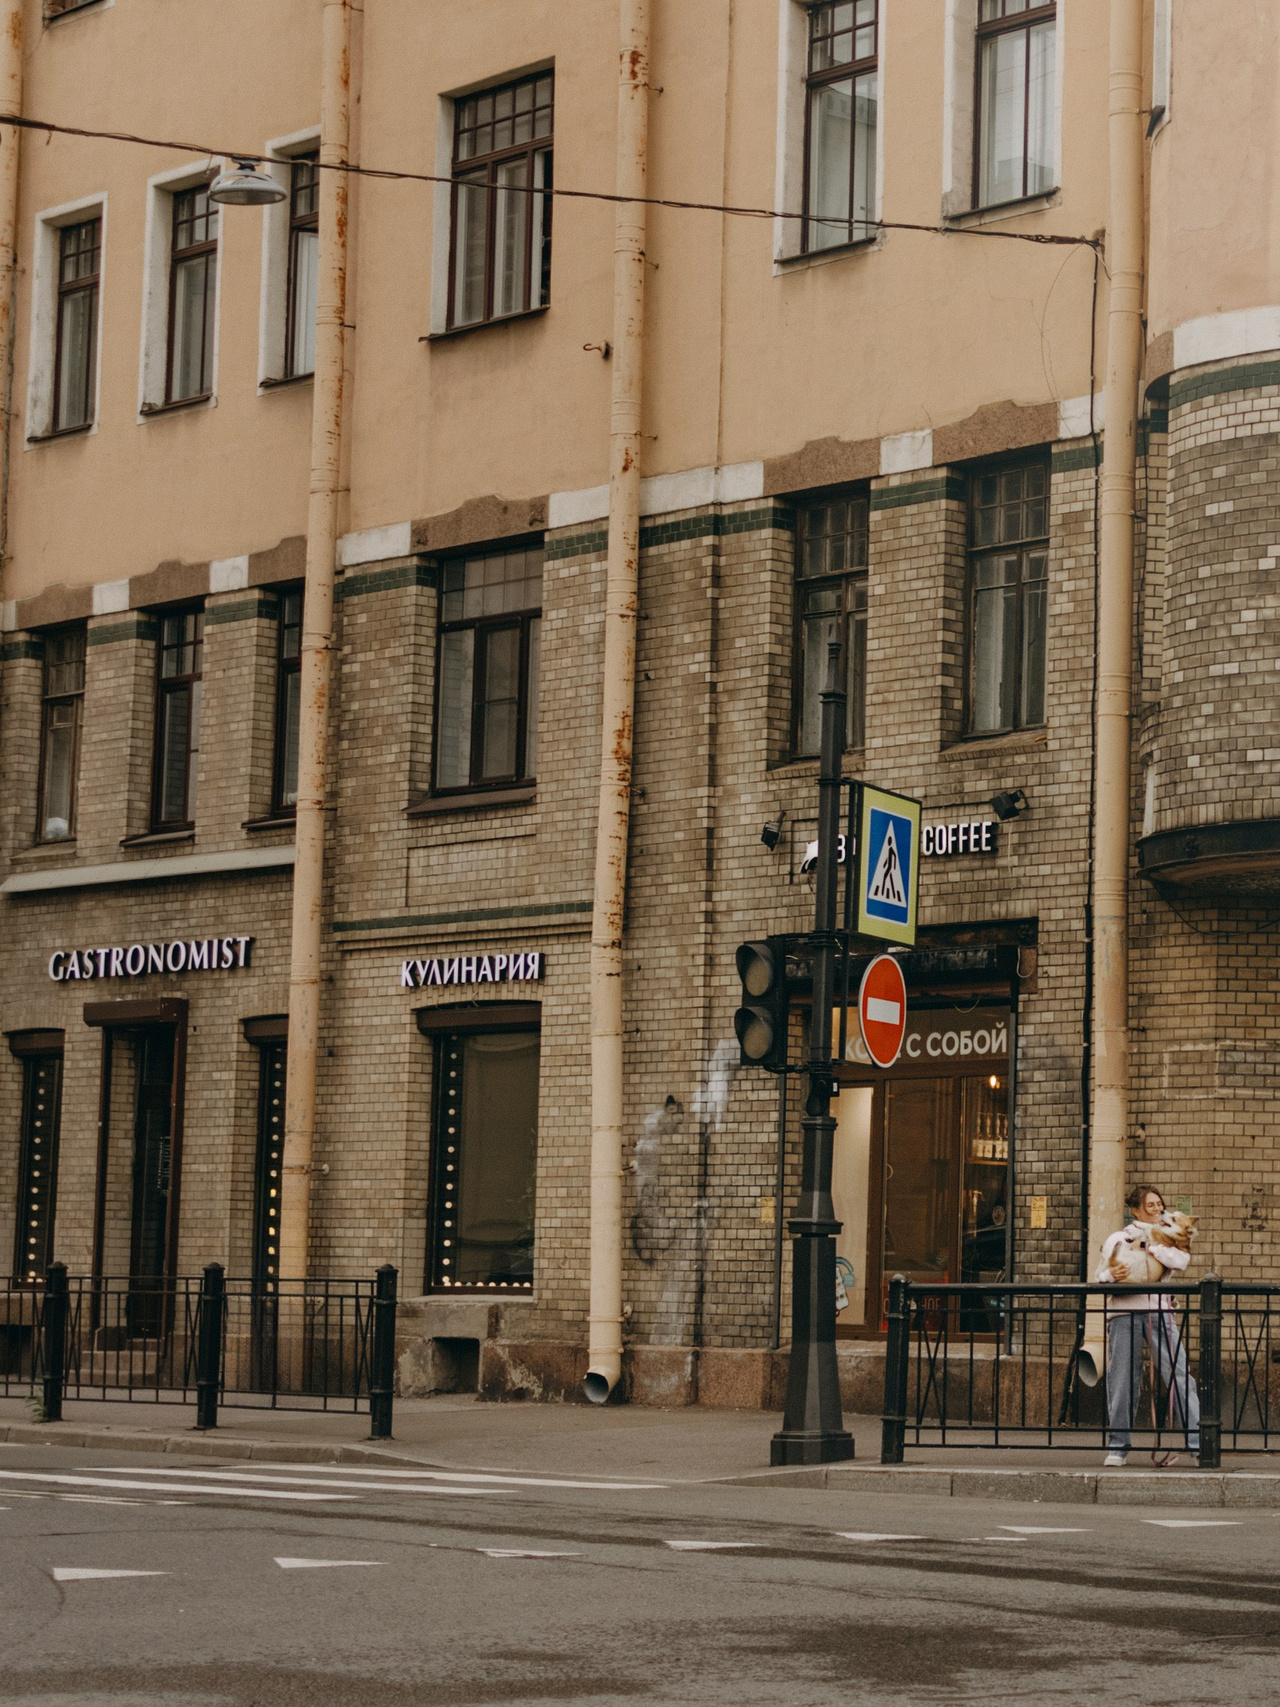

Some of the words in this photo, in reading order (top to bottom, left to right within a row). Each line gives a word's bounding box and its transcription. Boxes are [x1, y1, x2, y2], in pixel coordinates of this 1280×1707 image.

[922, 821, 993, 857] COFFEE
[48, 935, 251, 982] GASTRONOMIST
[401, 951, 541, 988] КУЛИНАРИЯ
[846, 1036, 902, 1060] КО
[905, 1032, 922, 1058] С
[926, 1021, 1008, 1057] СОБОЙ
